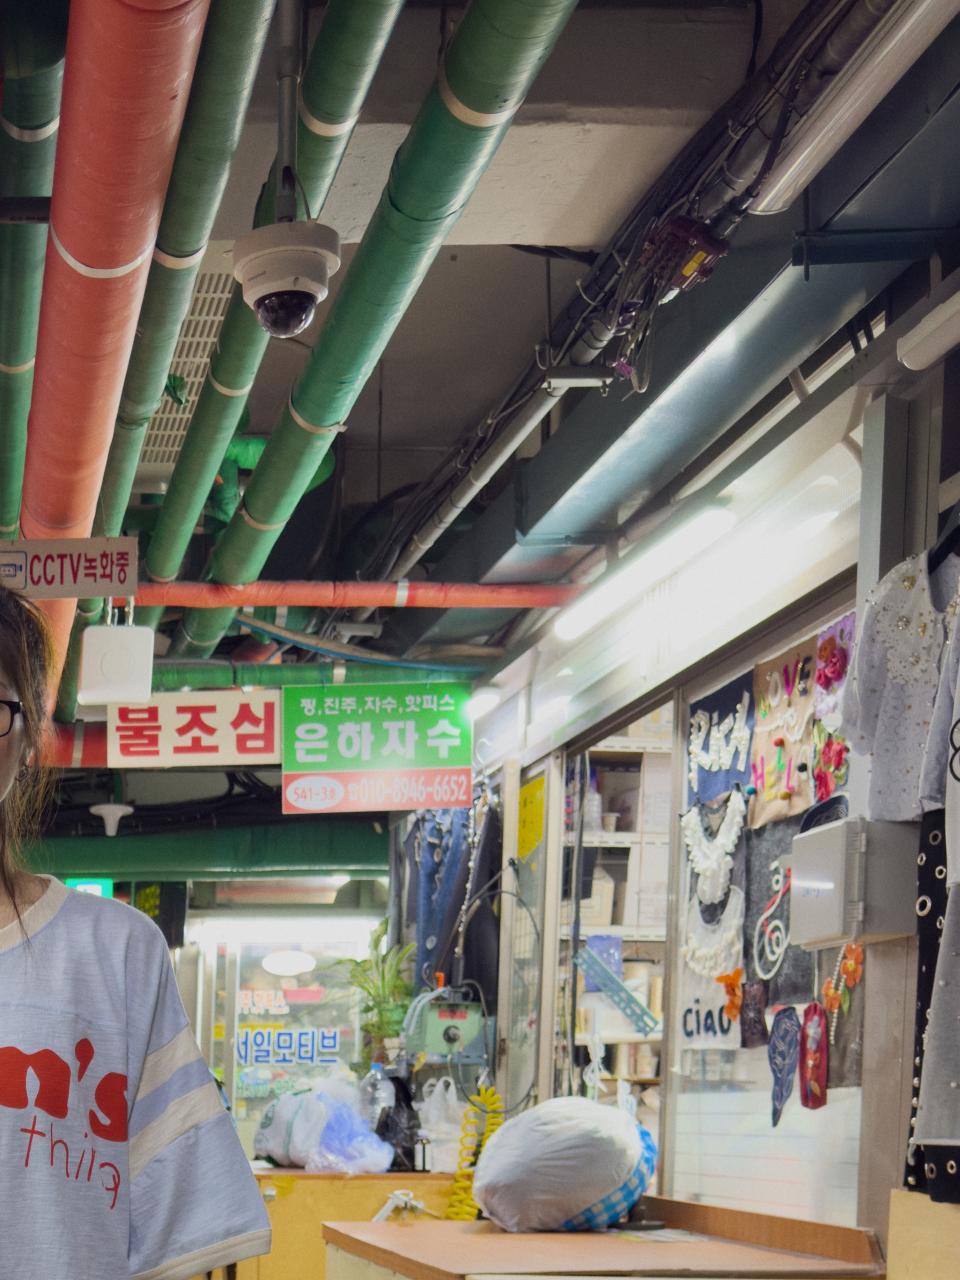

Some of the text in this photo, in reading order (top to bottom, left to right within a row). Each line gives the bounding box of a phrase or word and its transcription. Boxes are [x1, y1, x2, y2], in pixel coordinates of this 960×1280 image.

[29, 551, 129, 586] CCTV녹화중
[115, 701, 276, 758] 불조심
[295, 719, 462, 763] 은하자수
